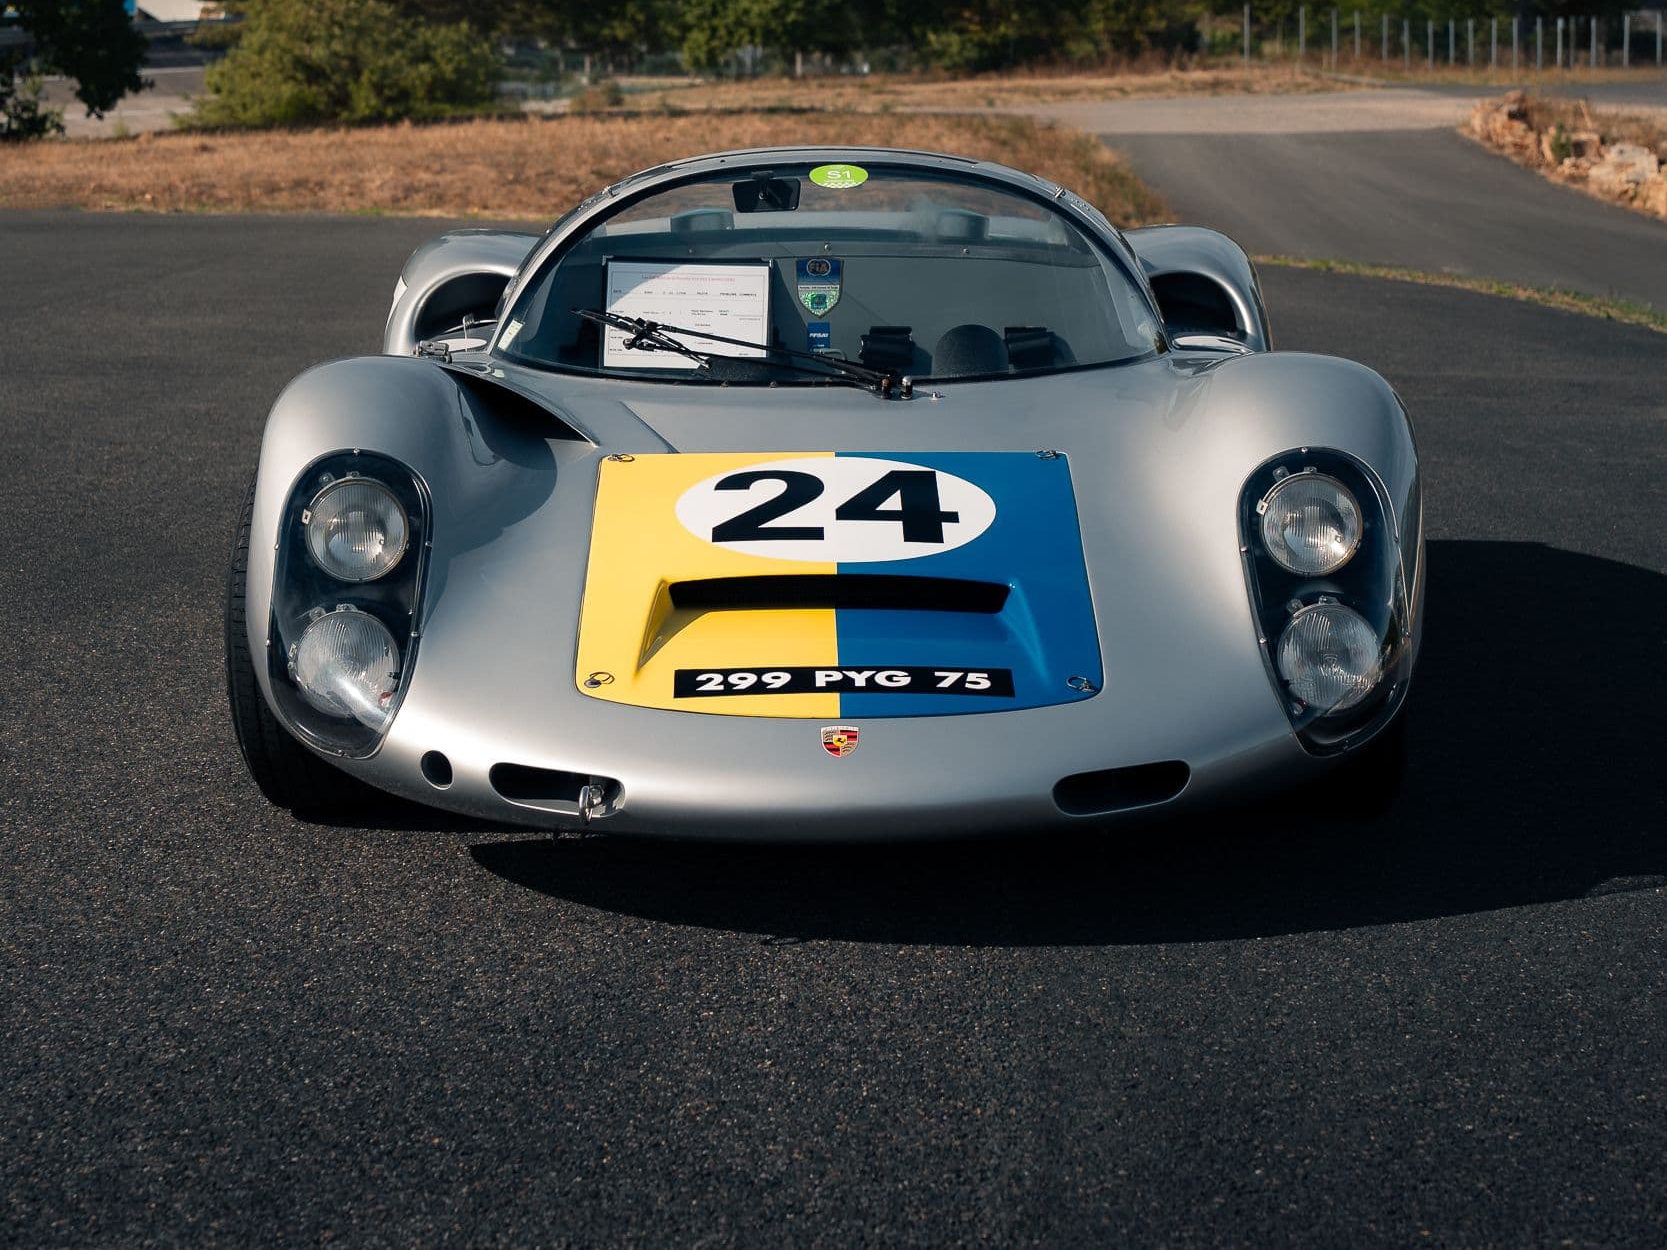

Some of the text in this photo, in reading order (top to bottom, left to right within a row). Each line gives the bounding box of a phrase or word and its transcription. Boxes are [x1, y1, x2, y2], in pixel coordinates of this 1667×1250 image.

[827, 170, 851, 180] S1
[809, 262, 828, 273] FIA
[711, 469, 960, 544] 24
[695, 670, 992, 691] 299 PYG 75
